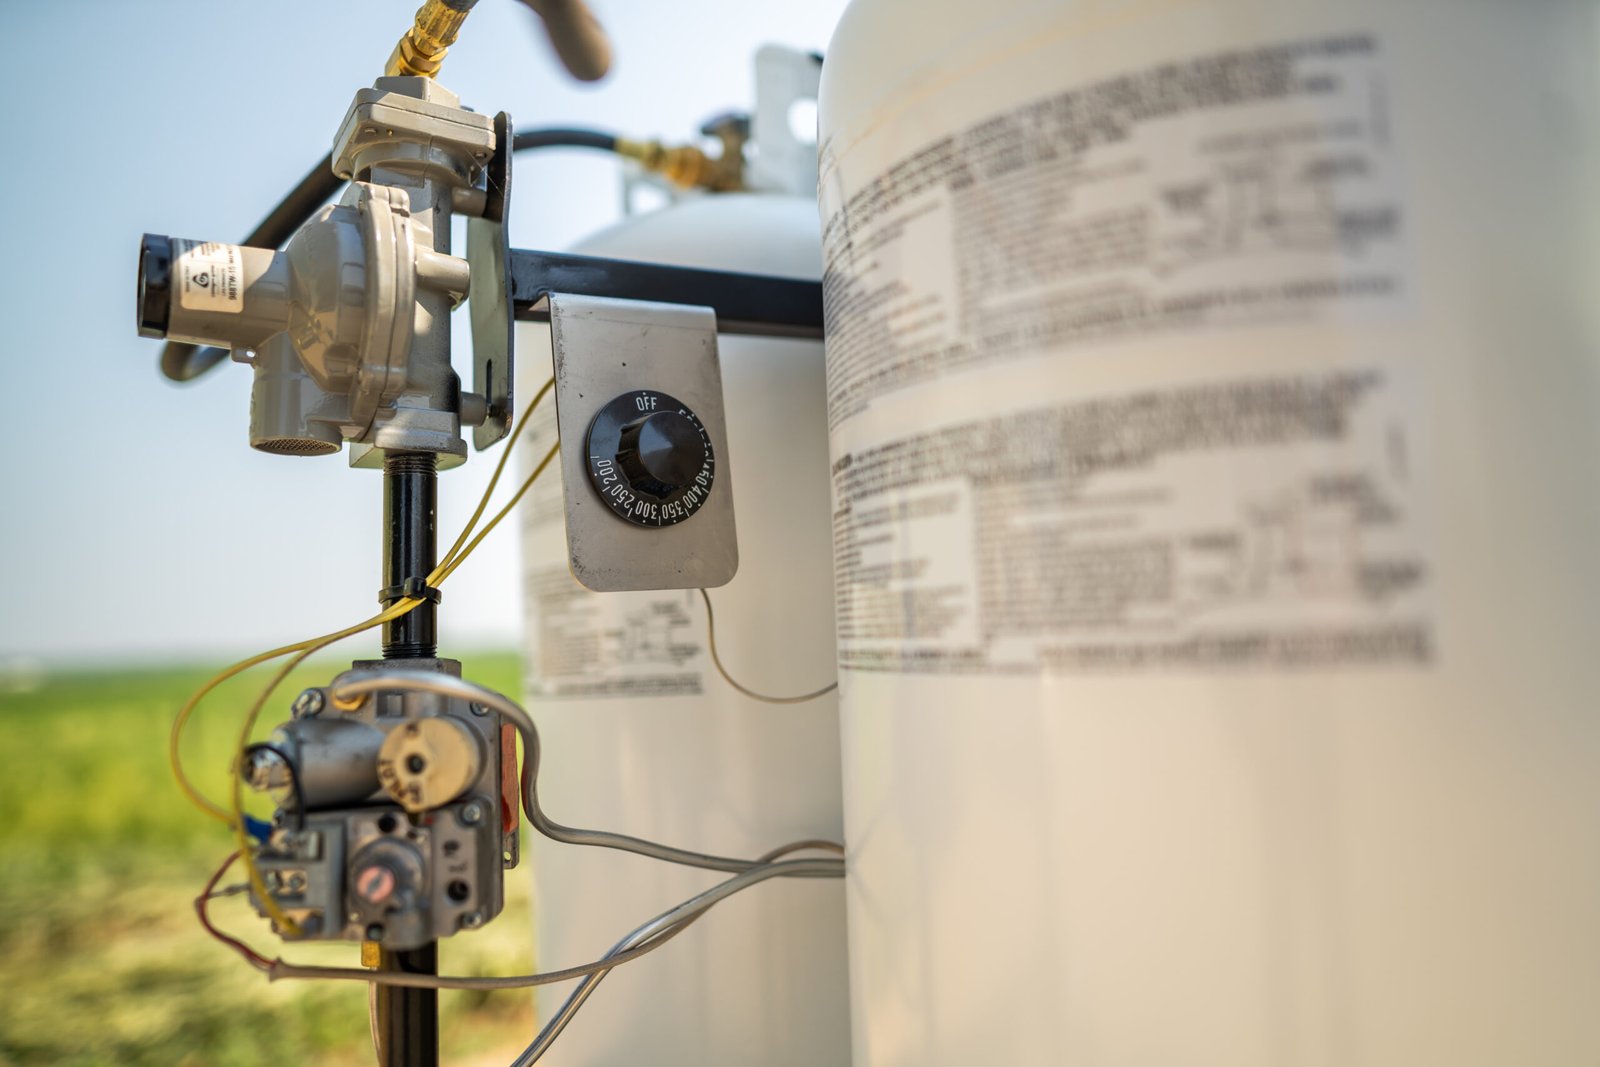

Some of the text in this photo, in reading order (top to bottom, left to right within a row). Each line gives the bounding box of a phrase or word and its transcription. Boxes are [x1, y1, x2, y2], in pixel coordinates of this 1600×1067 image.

[635, 396, 658, 411] OFF
[596, 459, 618, 486] 200
[611, 484, 635, 508] 250
[682, 484, 703, 509] 400
[635, 500, 658, 520] 300
[661, 501, 684, 520] 350
